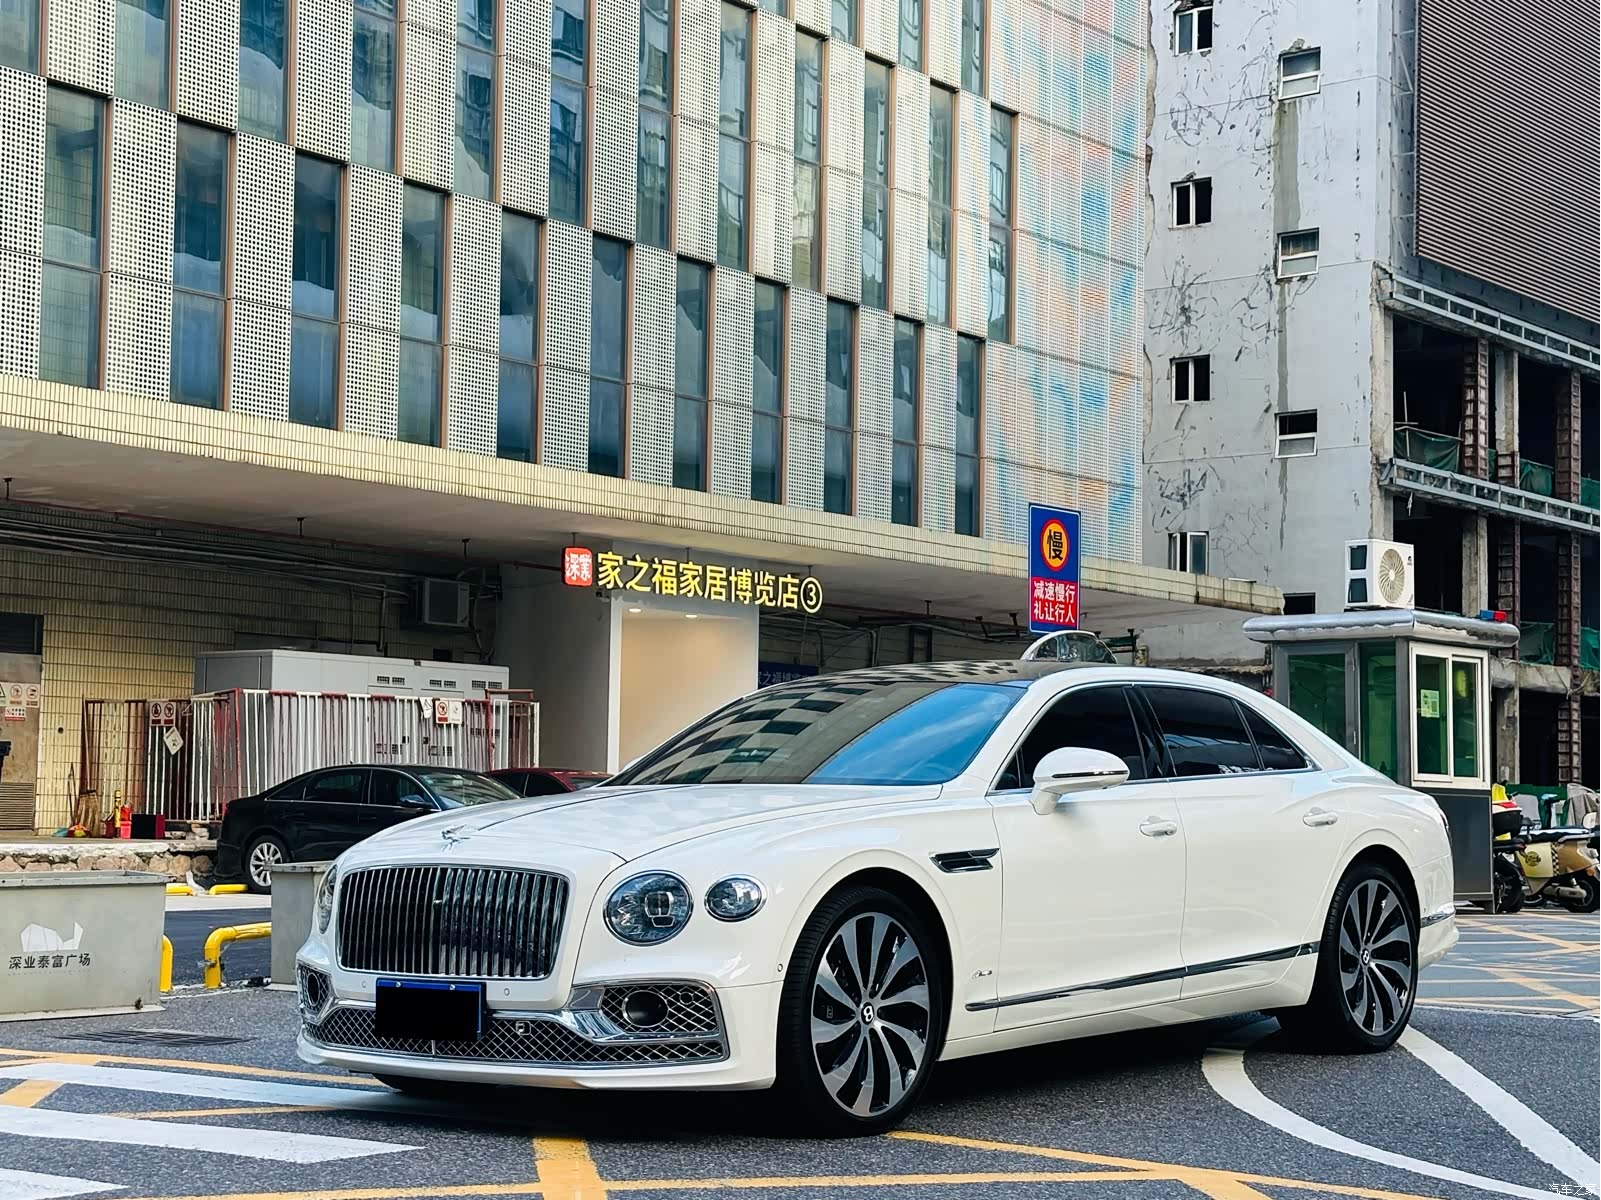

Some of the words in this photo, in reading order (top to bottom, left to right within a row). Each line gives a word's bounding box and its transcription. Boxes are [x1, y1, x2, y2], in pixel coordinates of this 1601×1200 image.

[1047, 529, 1064, 561] 慢
[1033, 580, 1076, 604] 减速慢行
[1033, 600, 1076, 624] 礼让行人
[8, 953, 91, 970] 深业泰富广场
